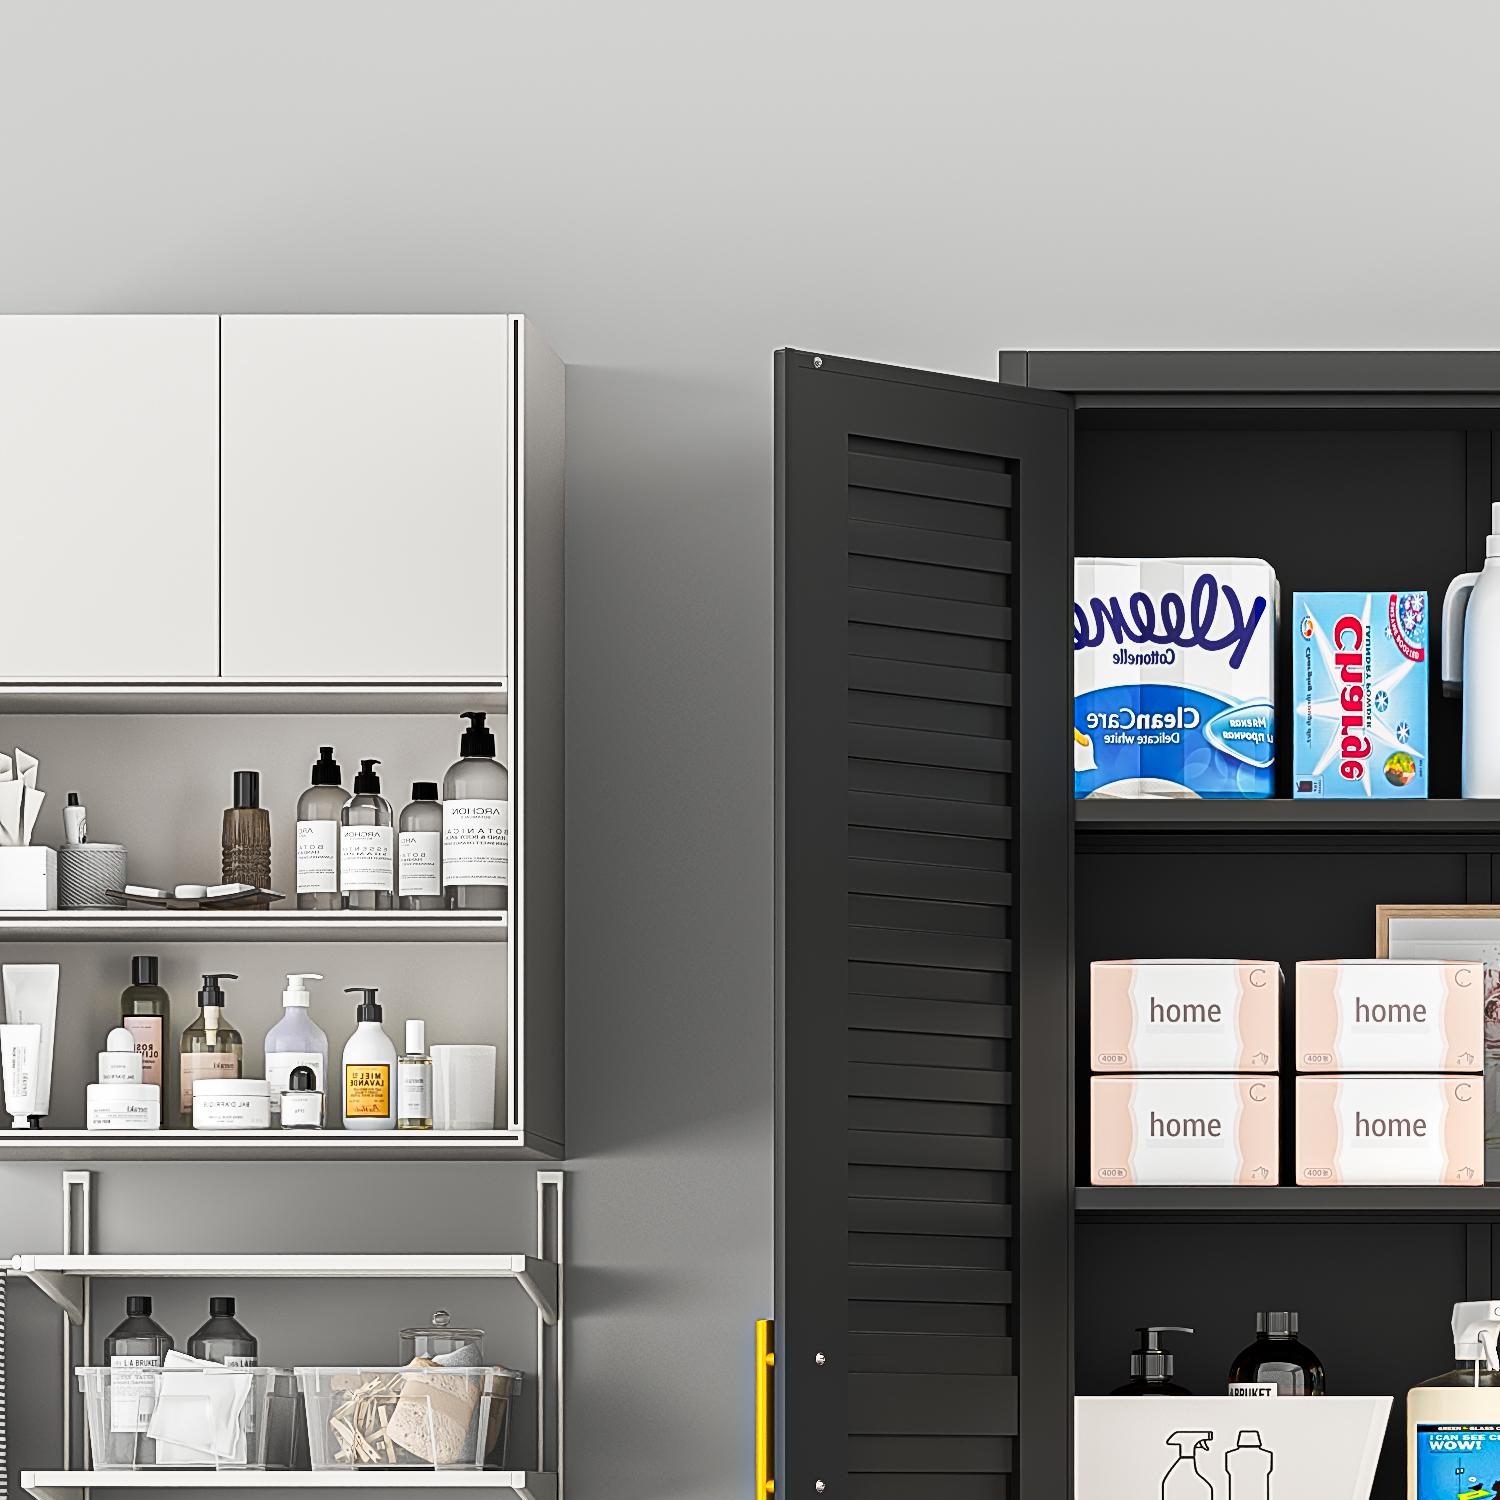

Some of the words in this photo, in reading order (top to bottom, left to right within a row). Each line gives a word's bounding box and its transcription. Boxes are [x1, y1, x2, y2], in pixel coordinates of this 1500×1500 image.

[1150, 997, 1222, 1023] home
[1355, 997, 1427, 1023] home
[1150, 1111, 1222, 1137] home
[1355, 1111, 1427, 1137] home
[1429, 1440, 1482, 1450] WOW!
